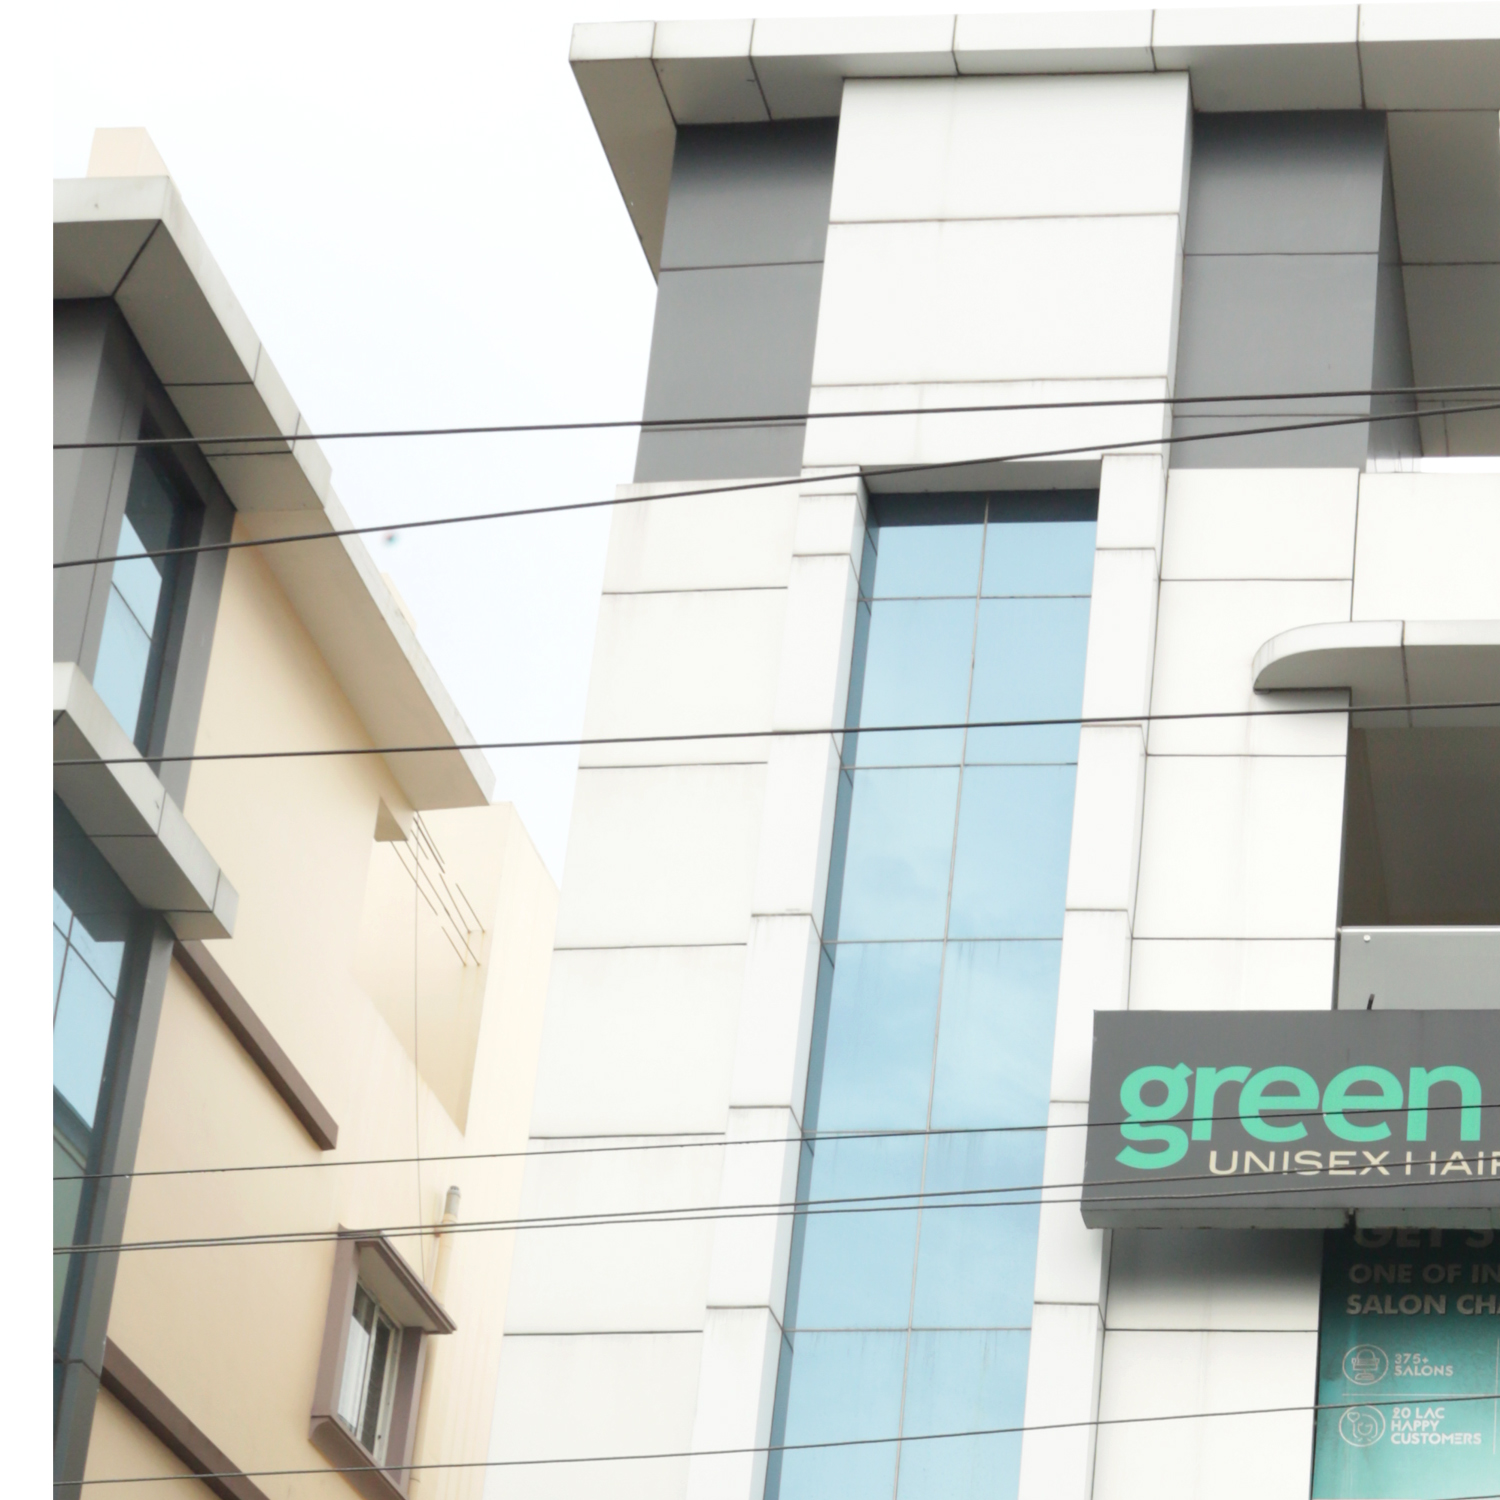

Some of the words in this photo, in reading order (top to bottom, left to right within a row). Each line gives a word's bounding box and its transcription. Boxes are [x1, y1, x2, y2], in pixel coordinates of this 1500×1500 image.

[1115, 1062, 1482, 1170] green
[1209, 1150, 1391, 1177] UNISEX
[1348, 1264, 1413, 1284] ONE
[1422, 1264, 1462, 1284] OF
[1346, 1294, 1447, 1316] SALON
[1394, 1353, 1429, 1365] 375+
[1394, 1365, 1454, 1377] SALONS
[1416, 1407, 1445, 1419] LAC
[1391, 1420, 1440, 1432] HAPPY
[1390, 1432, 1482, 1445] CUSTOMERS
